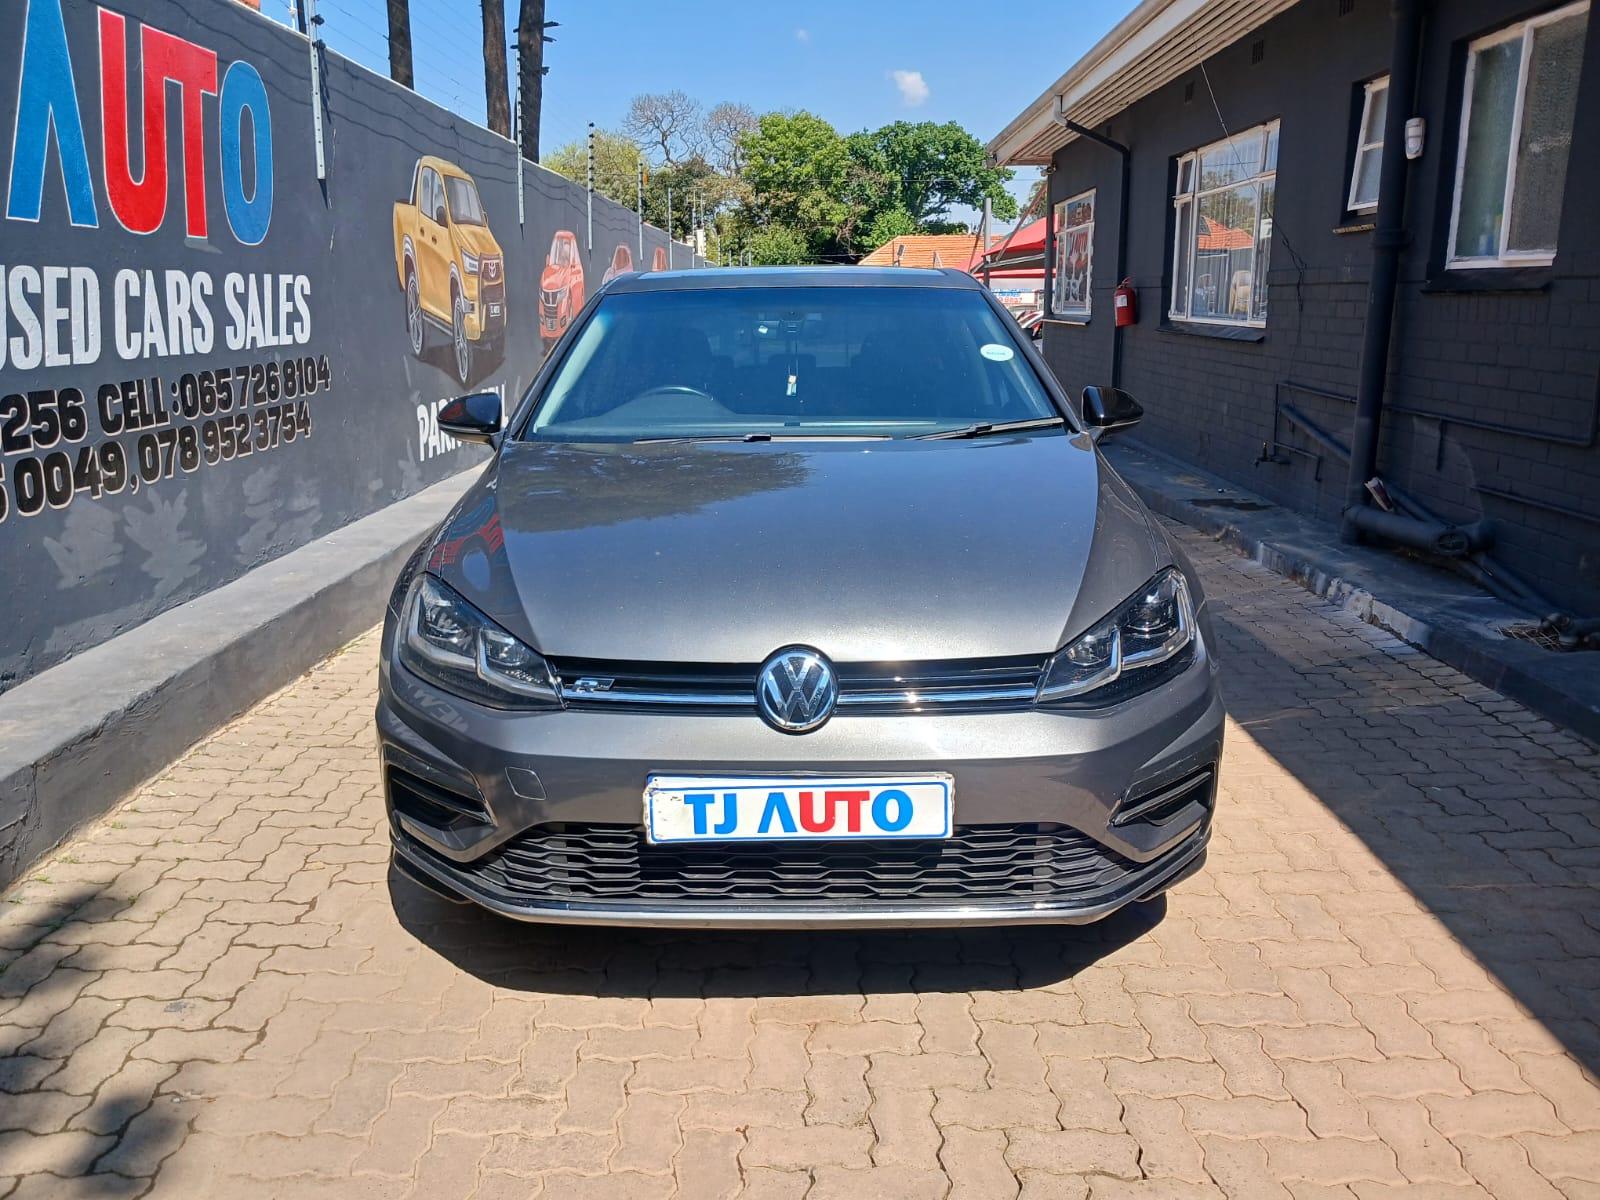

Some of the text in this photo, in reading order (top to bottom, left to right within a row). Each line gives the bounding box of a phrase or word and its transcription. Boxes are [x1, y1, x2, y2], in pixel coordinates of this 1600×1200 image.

[6, 0, 273, 245] AUTO
[114, 268, 214, 360] CARS
[224, 272, 312, 350] SALES
[684, 789, 913, 834] TJ AUTO
